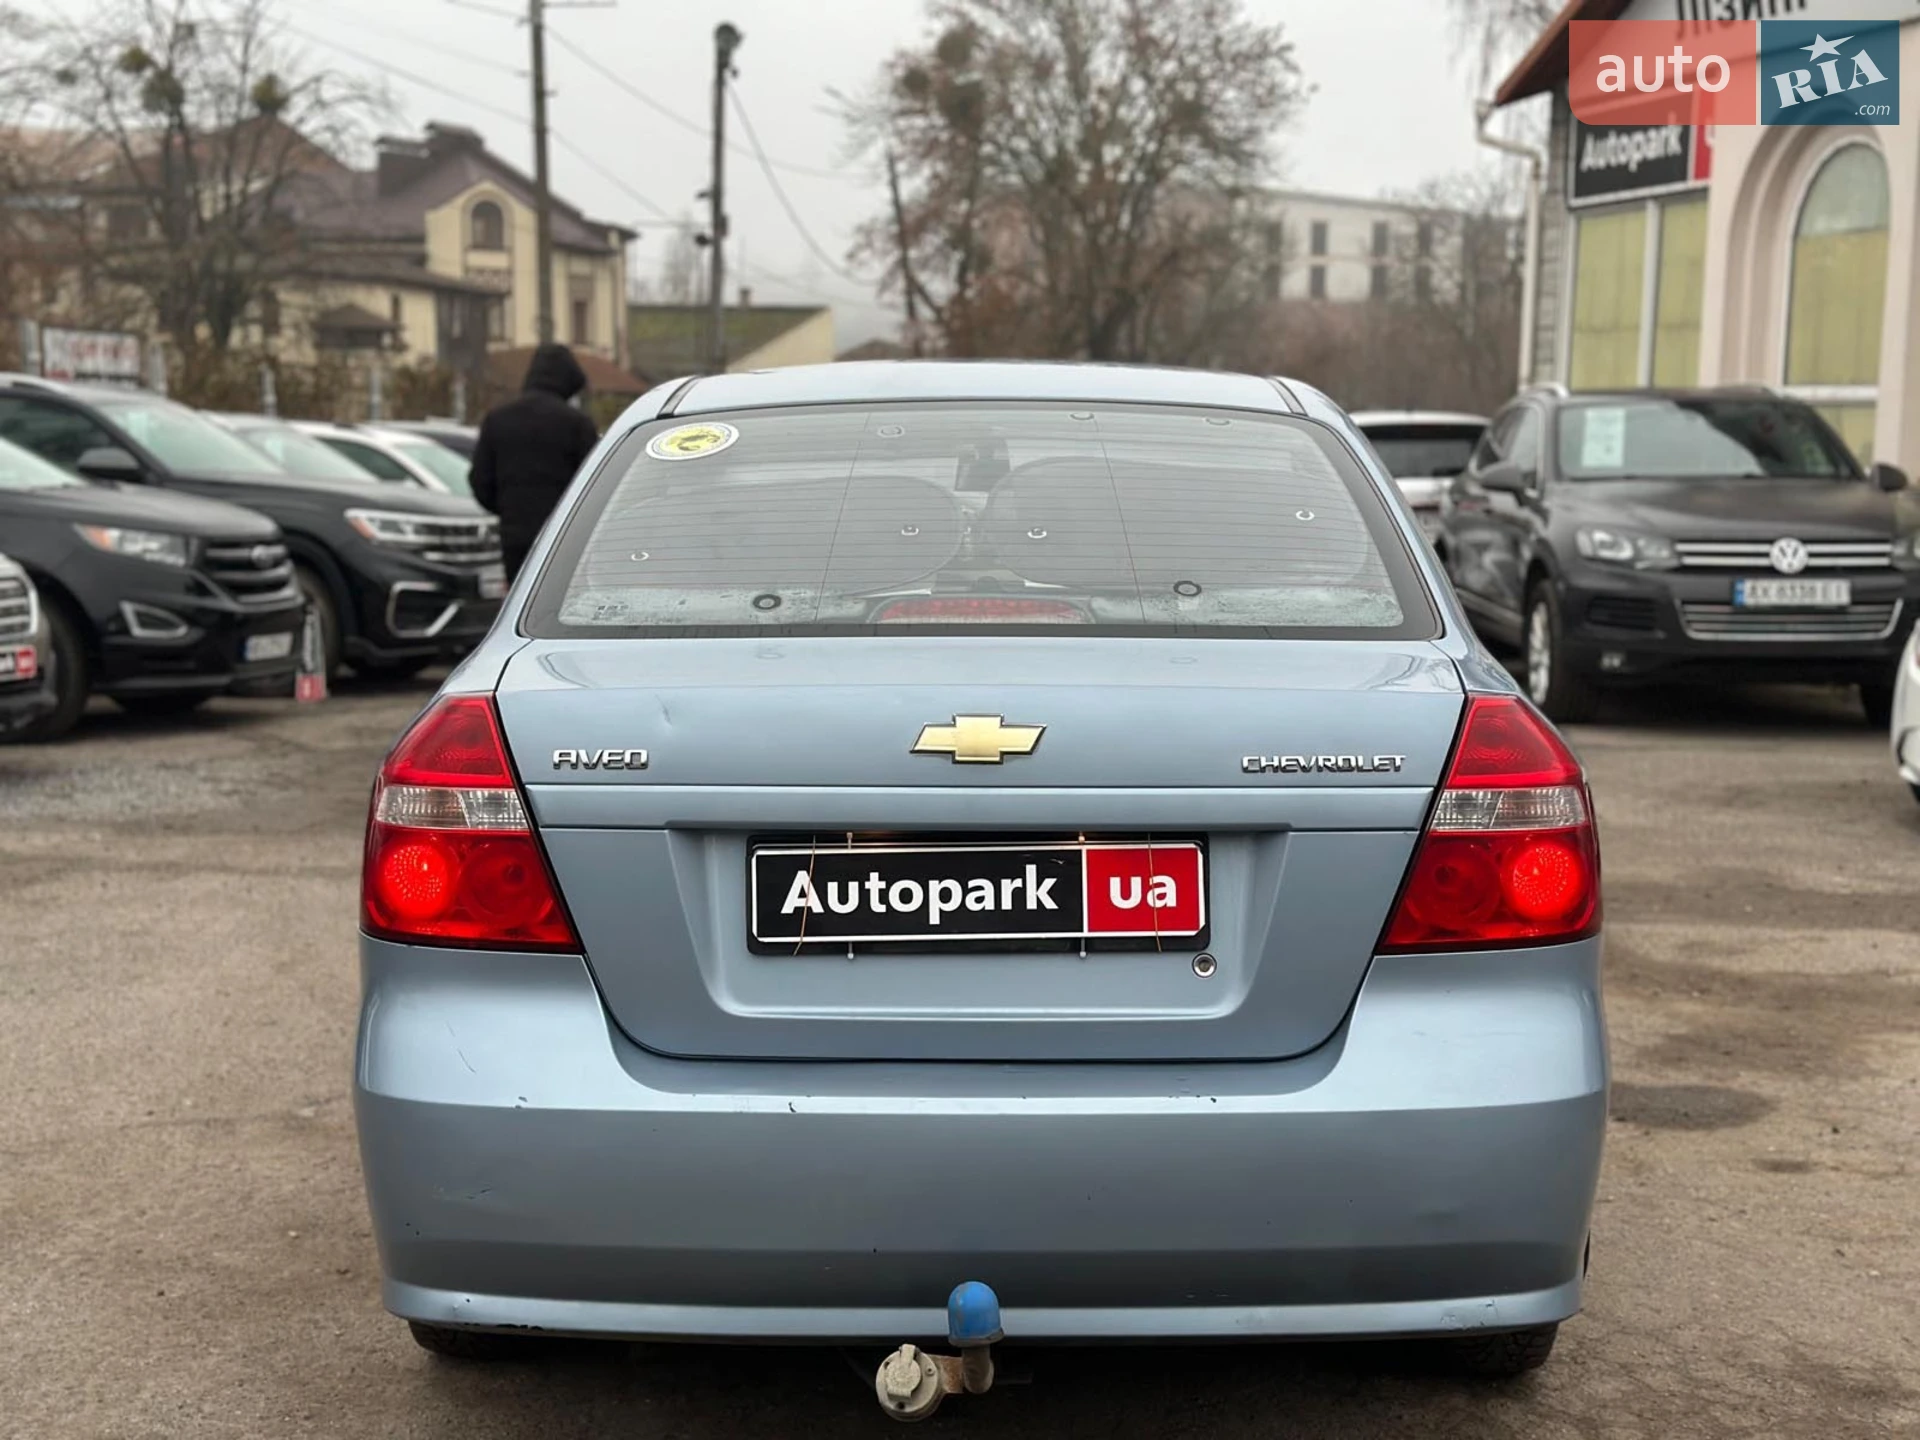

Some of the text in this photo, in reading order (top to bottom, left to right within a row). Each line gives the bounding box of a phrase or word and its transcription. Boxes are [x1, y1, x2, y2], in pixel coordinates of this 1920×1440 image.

[1580, 111, 1682, 172] Autopark
[553, 749, 649, 770] AVEO
[1241, 754, 1406, 773] CHEVROLET
[780, 864, 1177, 925] Autopark ua
